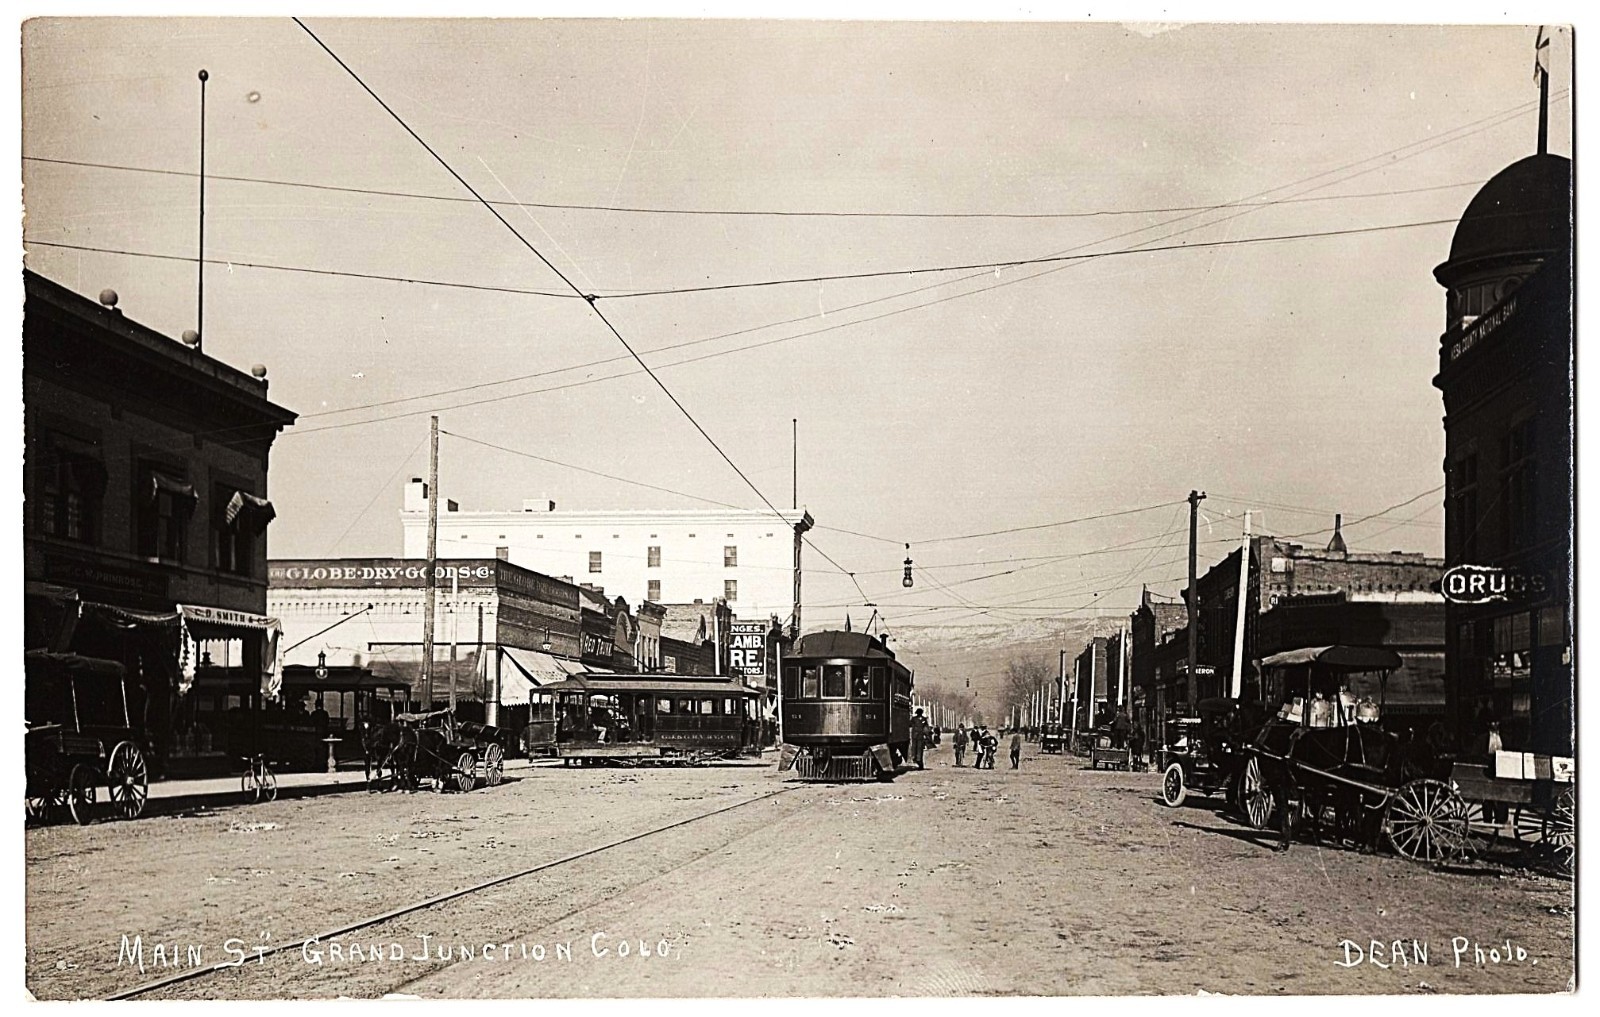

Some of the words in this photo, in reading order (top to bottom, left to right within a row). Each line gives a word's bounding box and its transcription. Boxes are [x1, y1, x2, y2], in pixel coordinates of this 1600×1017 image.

[361, 567, 399, 579] DRY
[1450, 574, 1545, 594] DRUGS
[217, 611, 245, 623] SMITH
[583, 635, 596, 654] RED
[730, 635, 764, 649] AMB.
